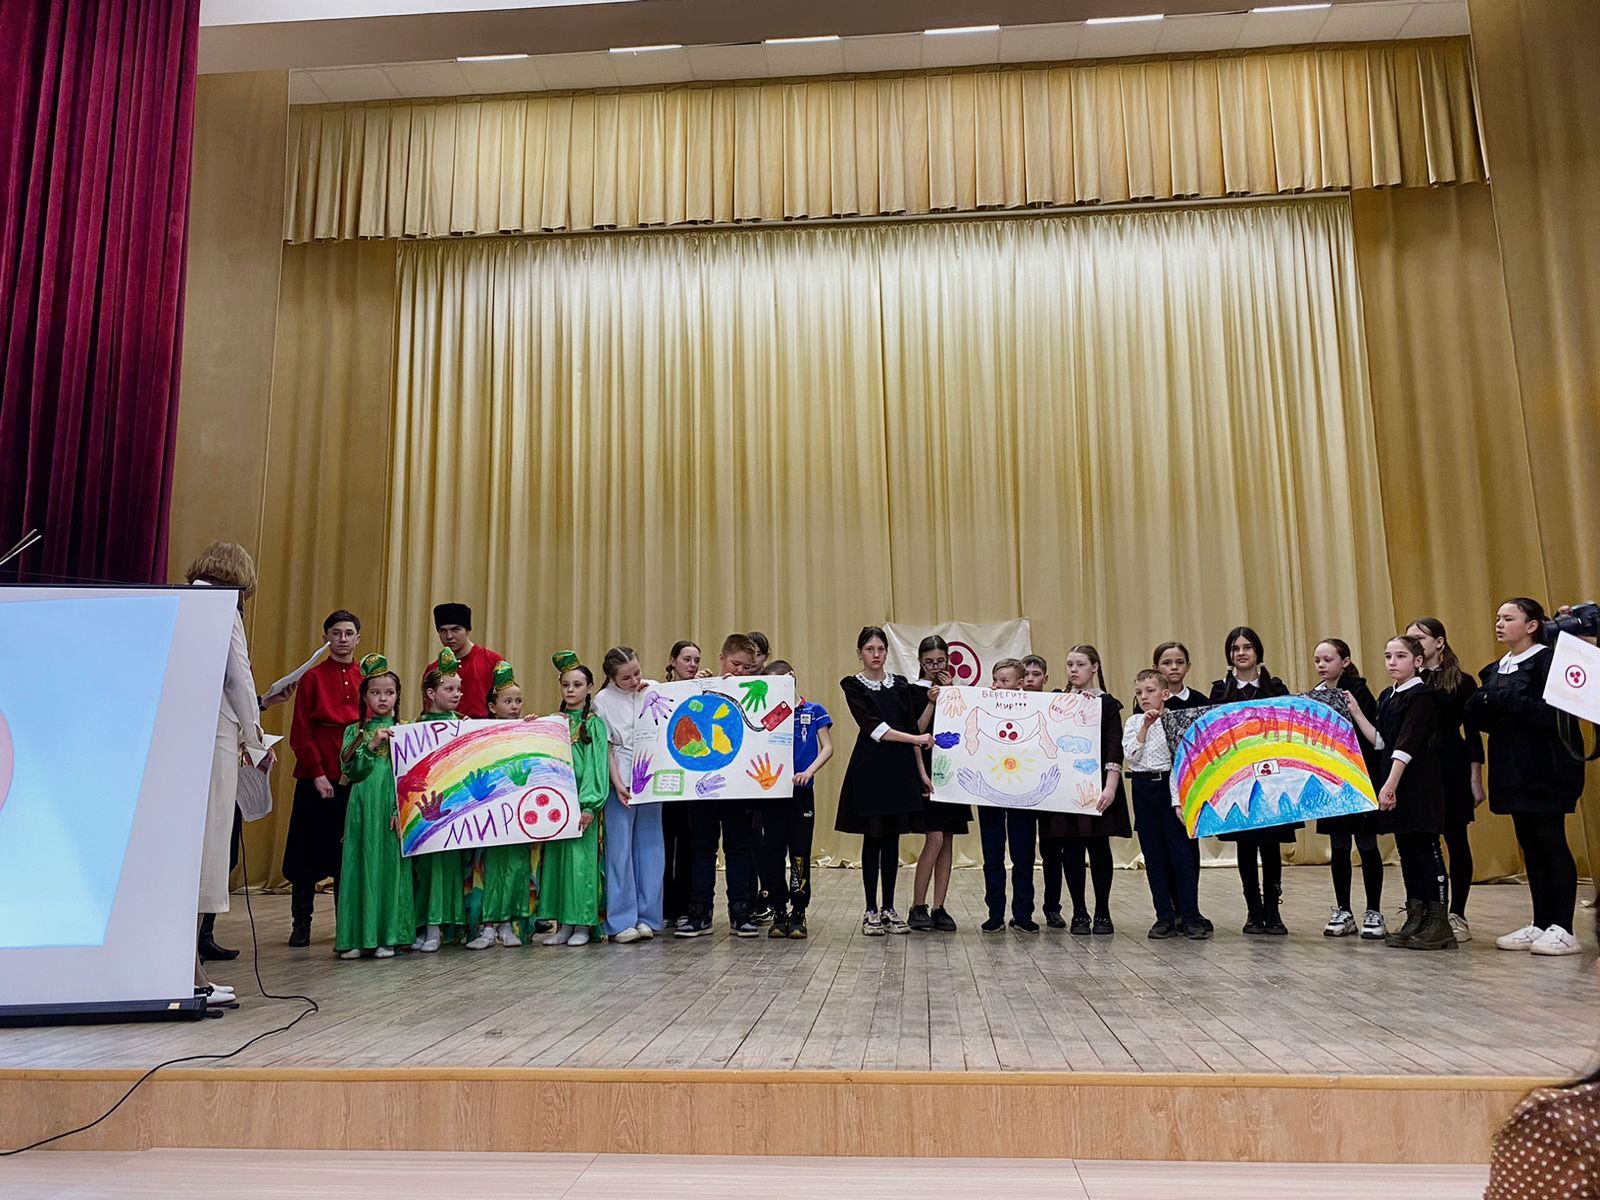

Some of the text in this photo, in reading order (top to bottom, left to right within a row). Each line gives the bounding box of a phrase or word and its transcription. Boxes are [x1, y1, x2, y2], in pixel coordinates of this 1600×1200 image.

[981, 690, 1028, 700] БЕРЕГИТЕ
[394, 720, 461, 776] МИРУ
[444, 802, 514, 848] МИР
